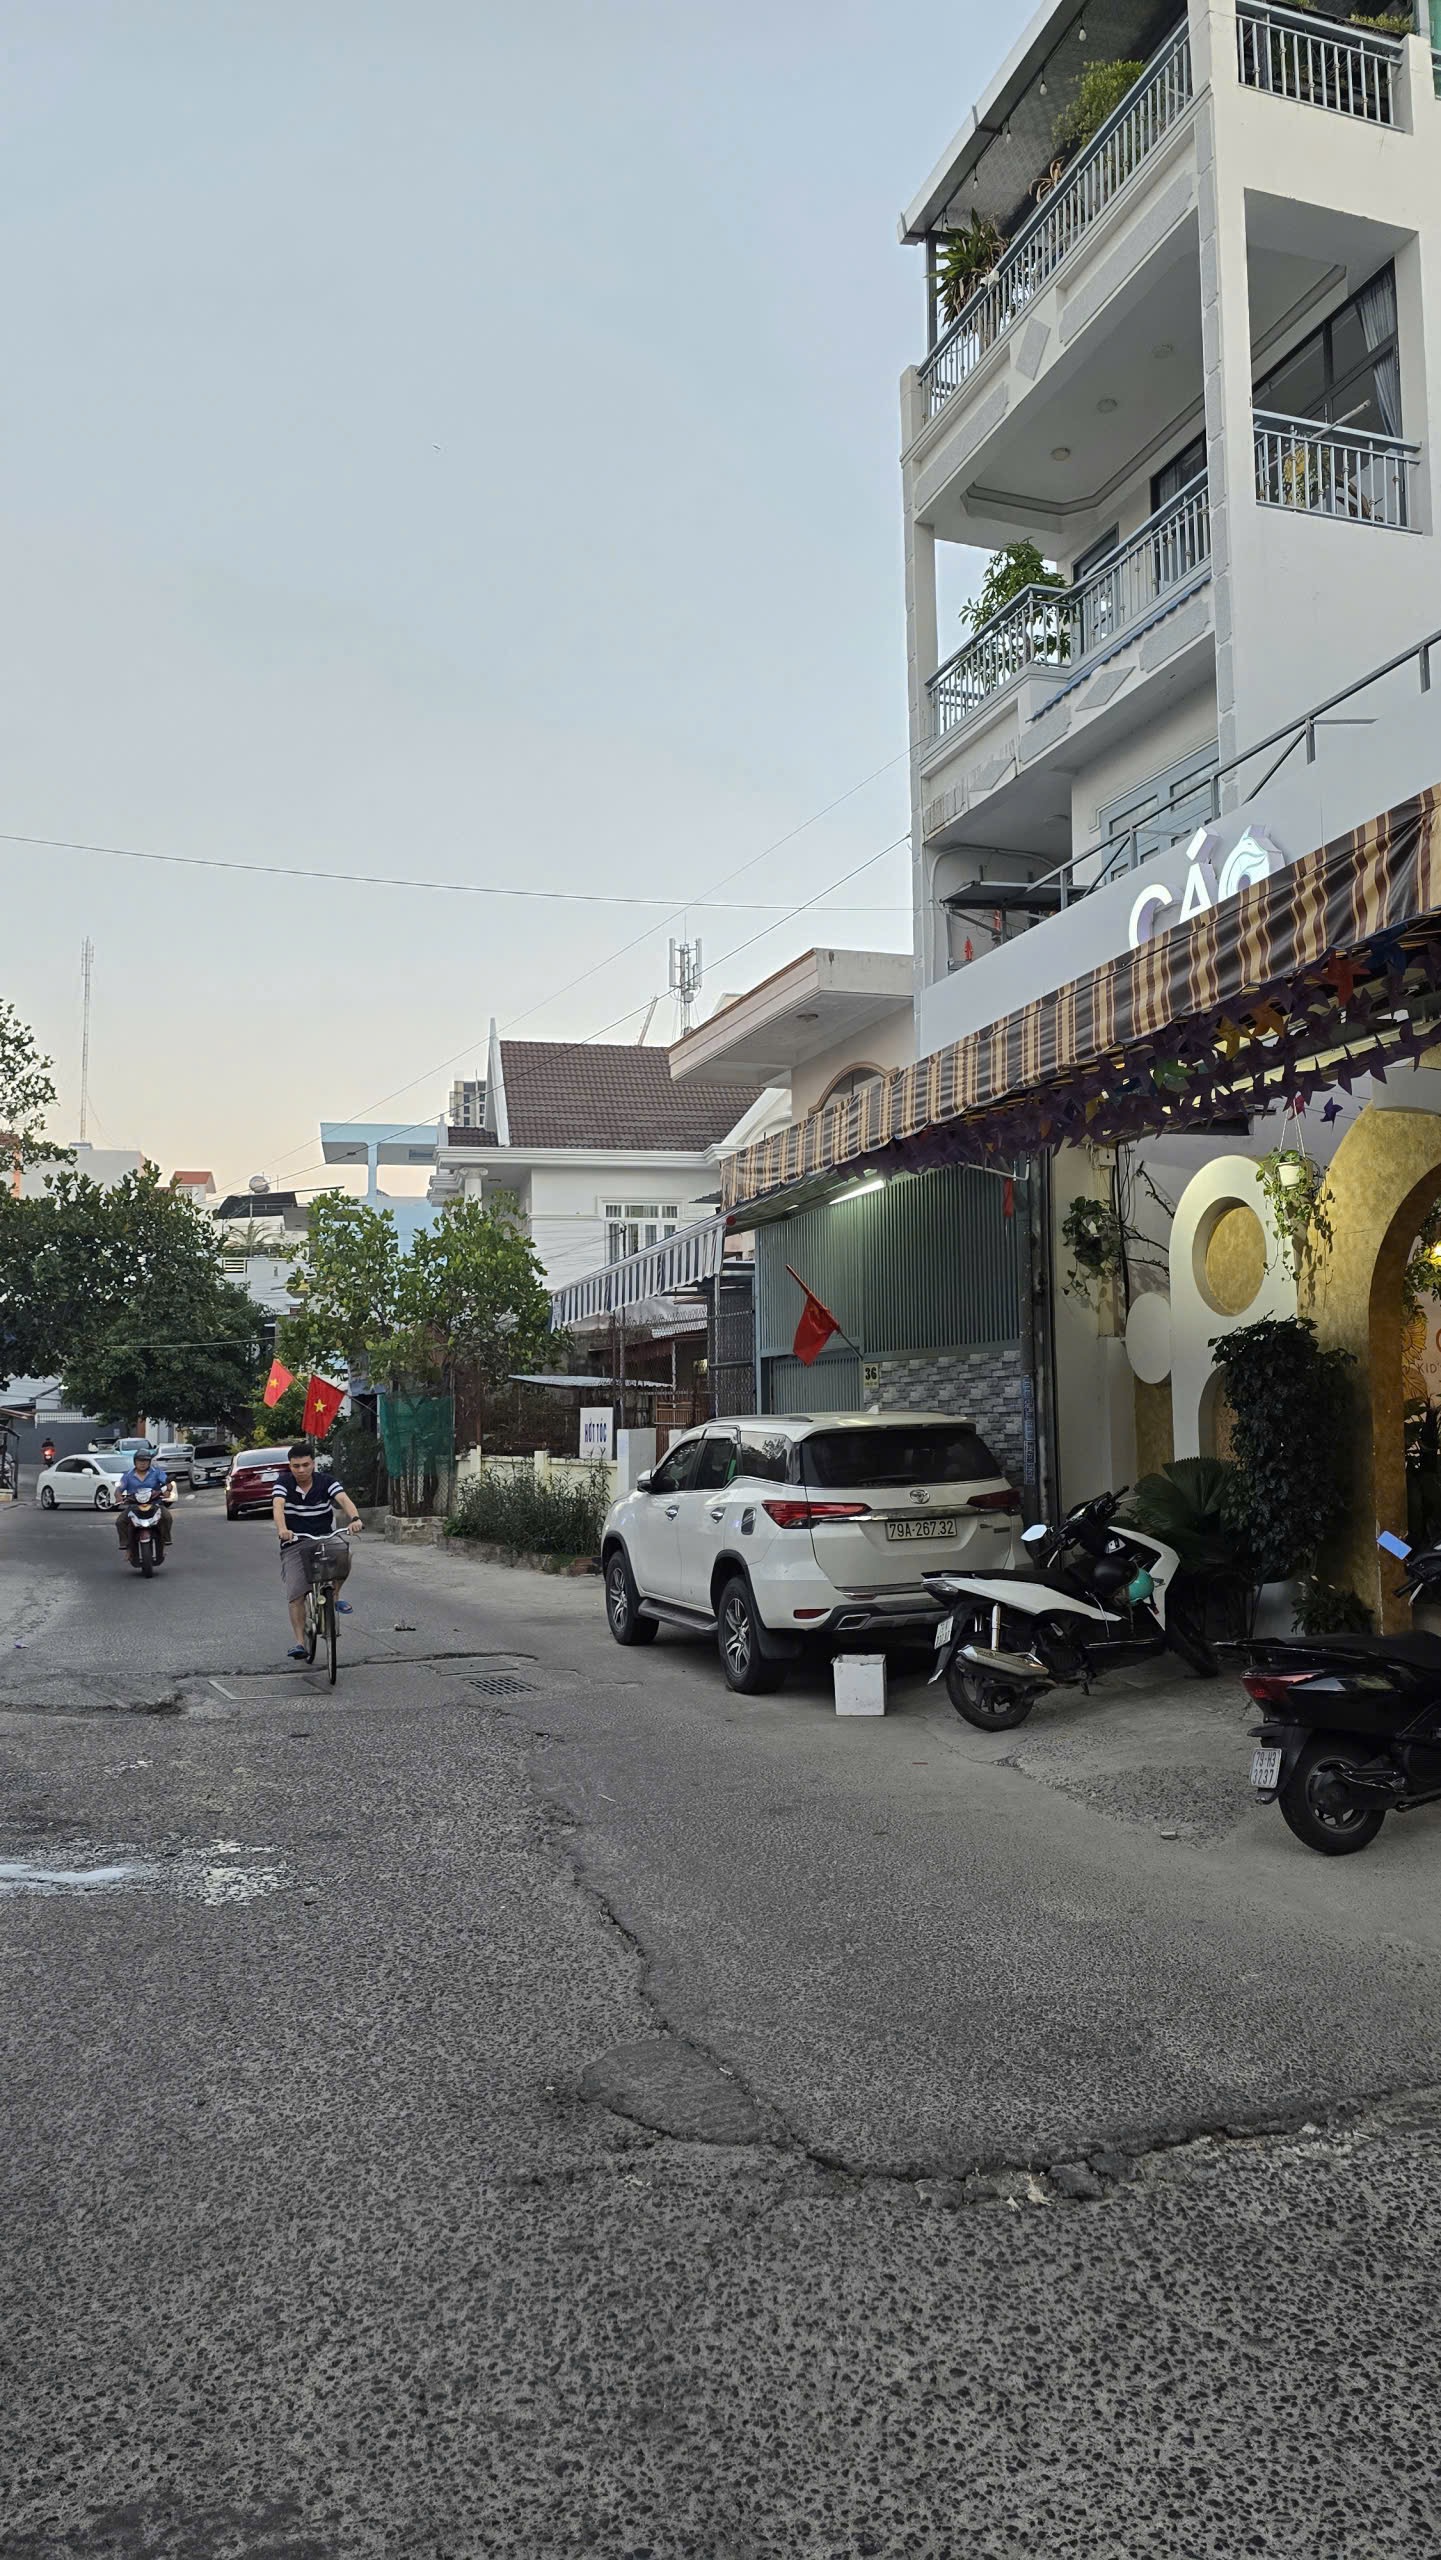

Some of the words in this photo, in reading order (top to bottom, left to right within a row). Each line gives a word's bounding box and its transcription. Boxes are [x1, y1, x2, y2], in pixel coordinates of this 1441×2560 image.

[865, 1366, 877, 1380] 36
[889, 1520, 955, 1538] 79A-267.32
[1252, 1769, 1274, 1784] 3237
